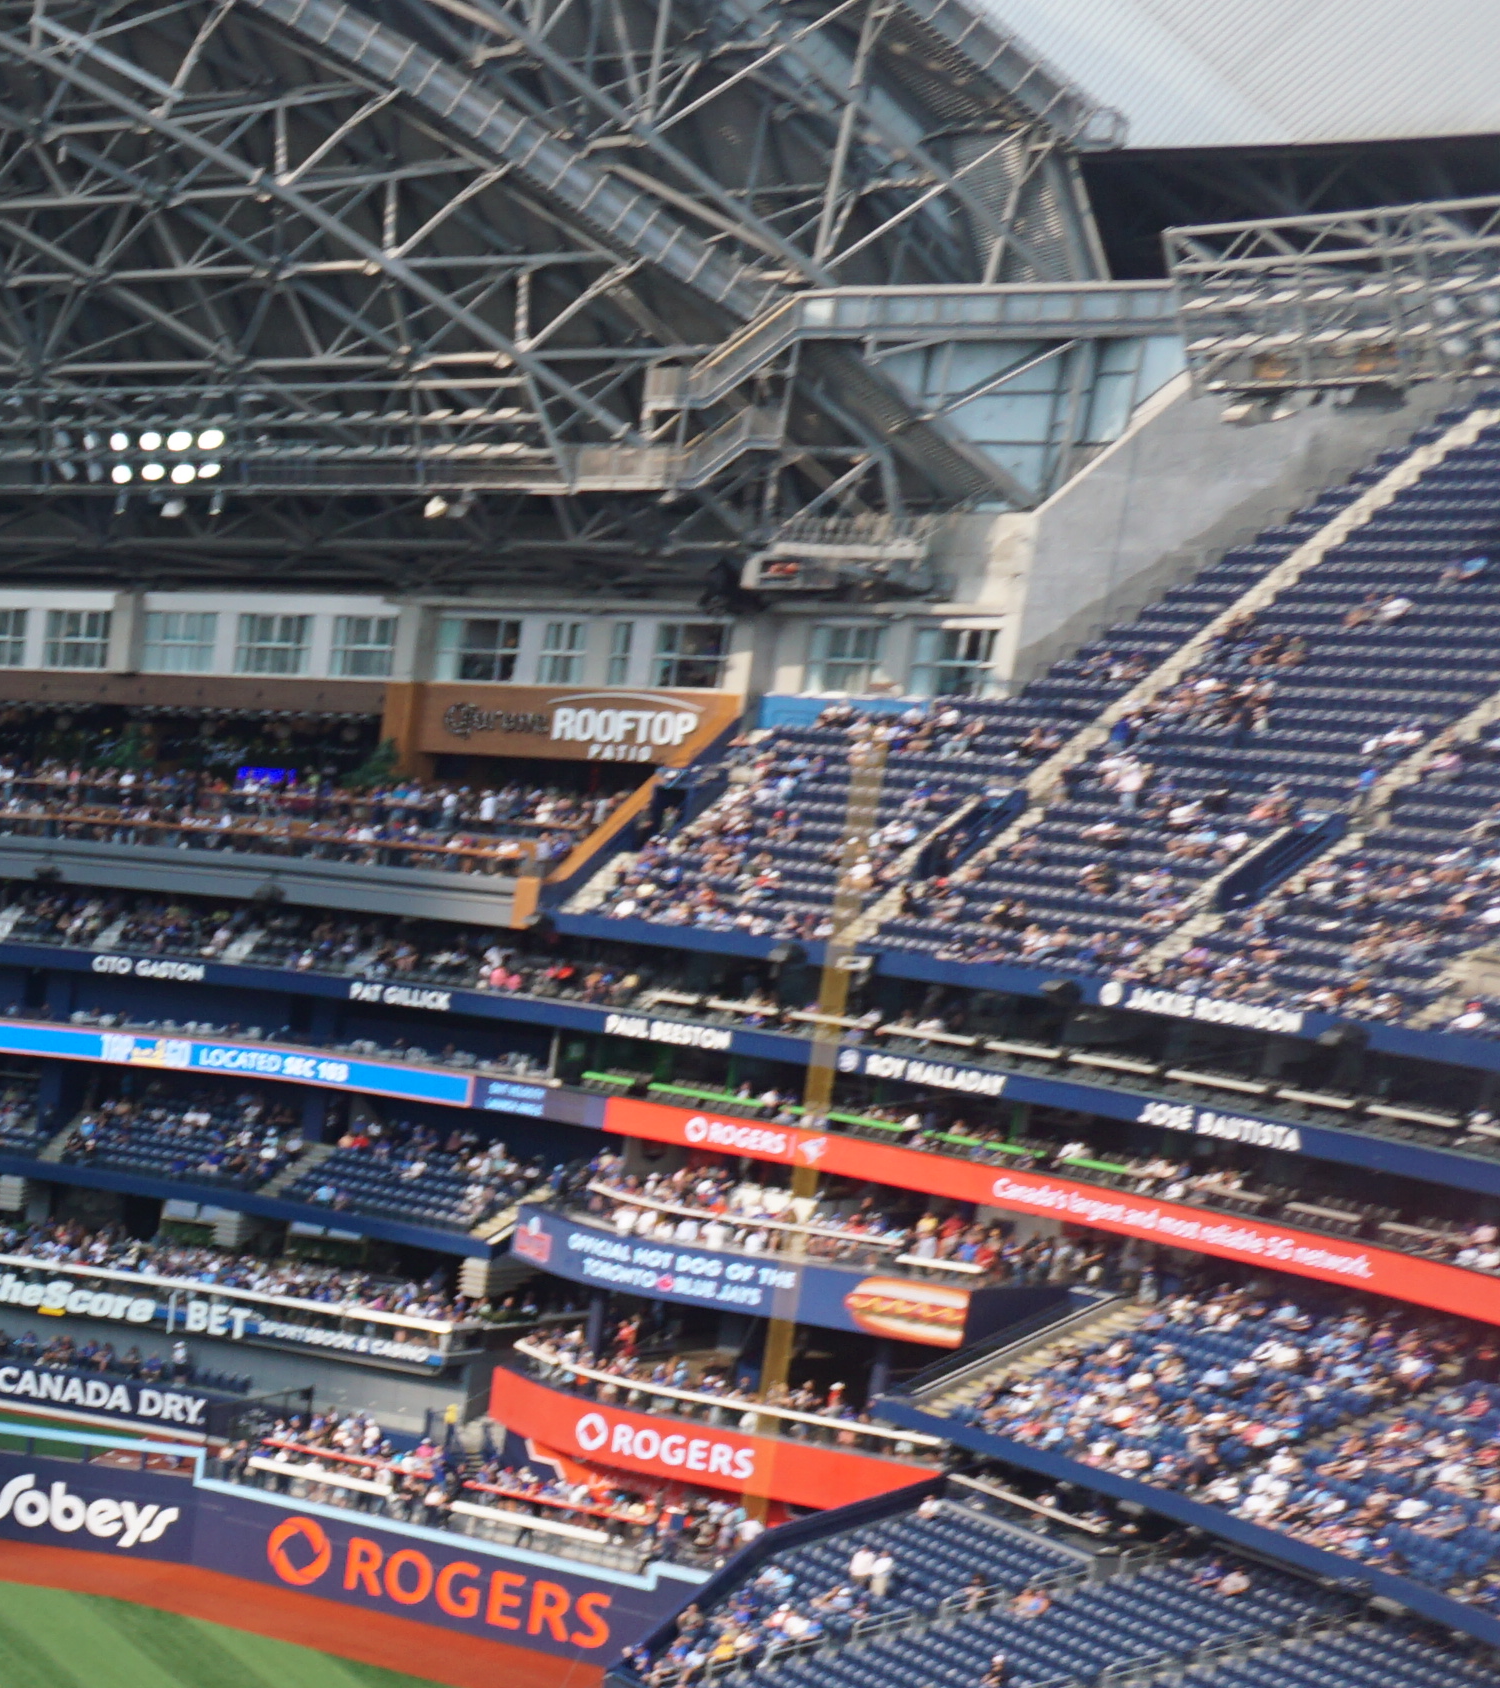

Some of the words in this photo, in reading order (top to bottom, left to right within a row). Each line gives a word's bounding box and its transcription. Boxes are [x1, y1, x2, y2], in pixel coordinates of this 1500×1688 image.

[551, 703, 698, 745] ROOFTOP
[587, 744, 652, 762] PATIO
[92, 956, 131, 975] CITO
[135, 960, 204, 982] GASTON
[350, 982, 381, 1002] PAT
[384, 986, 451, 1010] GILLICK
[1126, 985, 1192, 1018] JACKIE
[1196, 996, 1302, 1033] ROBINSON
[605, 1015, 650, 1042] PAUL
[654, 1020, 732, 1050] BEESTON
[201, 1048, 279, 1072] LOCATED
[282, 1055, 314, 1077] SEC
[317, 1060, 350, 1083] 103
[866, 1051, 907, 1080] ROY
[909, 1060, 1006, 1097] HALLADAY
[707, 1122, 787, 1154] ROGERS
[1138, 1099, 1194, 1132] JOSÉ
[1197, 1112, 1301, 1152] BAUTISTA
[992, 1178, 1068, 1210] Canada's
[1069, 1191, 1126, 1223] largest
[1124, 1208, 1160, 1230] and
[1158, 1216, 1201, 1238] most
[1202, 1224, 1267, 1254] reliable
[1265, 1236, 1294, 1260] 5G
[568, 1232, 631, 1262] OFFICIAL
[632, 1247, 674, 1270] HOT
[675, 1254, 723, 1277] DOG
[725, 1262, 756, 1282] OF
[759, 1268, 798, 1289] THE
[582, 1257, 658, 1288] TORONTO
[673, 1276, 717, 1299] BLUE
[717, 1284, 762, 1306] JAYS
[186, 1300, 252, 1339] BET
[259, 1321, 355, 1352] SPORTSBOOK
[372, 1341, 430, 1363] CASINO
[609, 1423, 755, 1479] ROGERS
[344, 1537, 612, 1649] ROGERS
